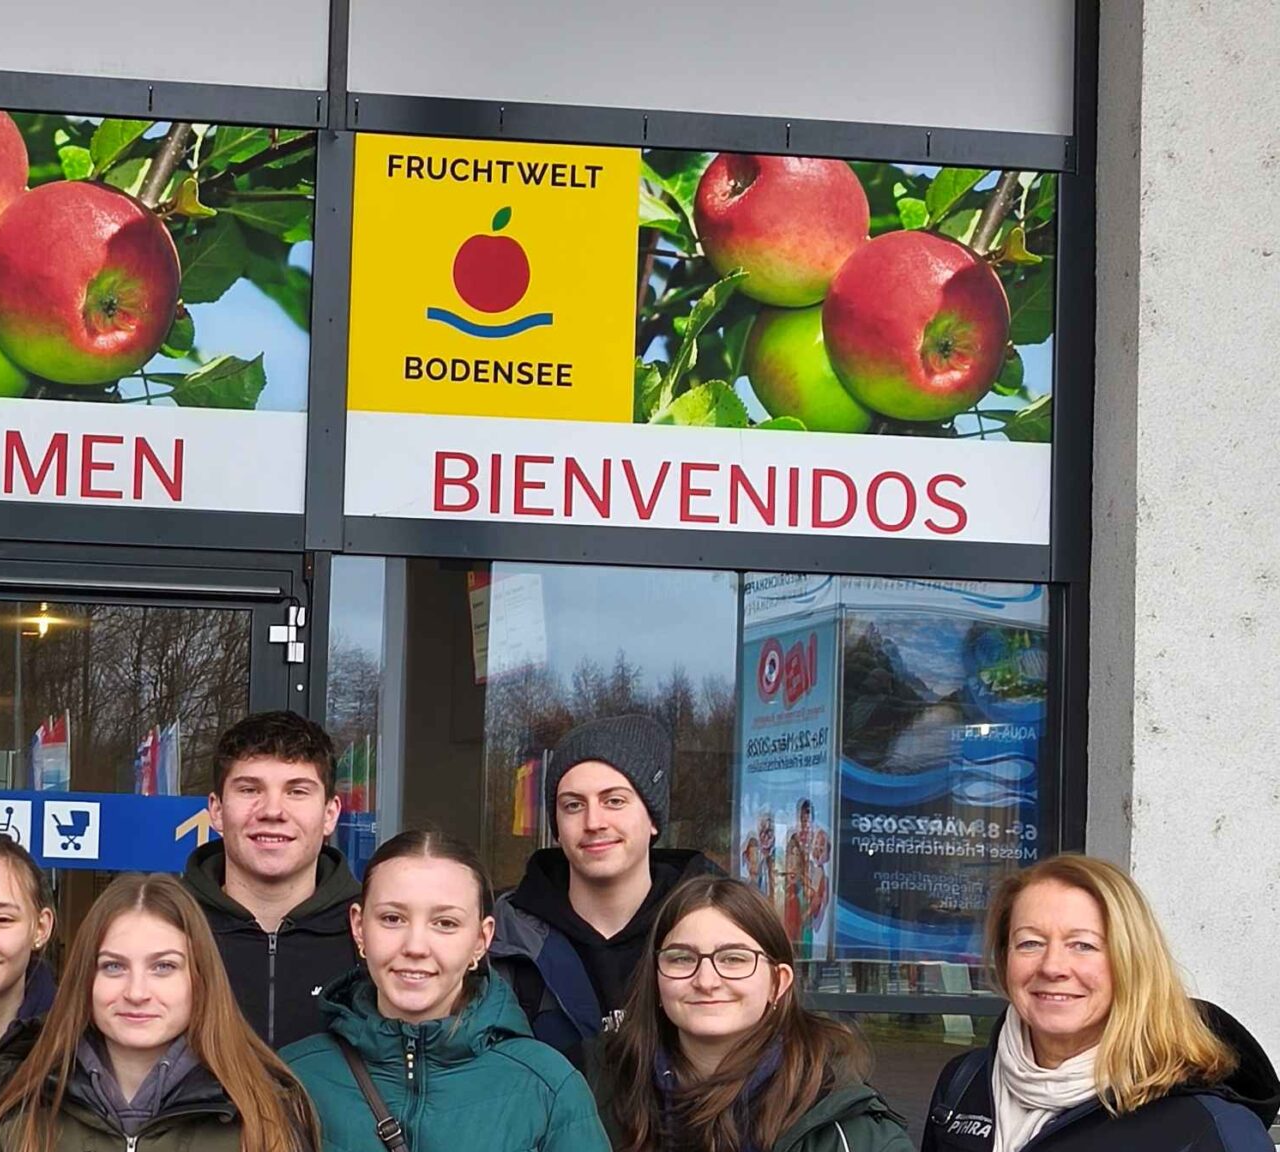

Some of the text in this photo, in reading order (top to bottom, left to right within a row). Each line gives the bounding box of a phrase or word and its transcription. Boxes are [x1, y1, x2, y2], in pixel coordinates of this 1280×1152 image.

[387, 154, 603, 188] FRUCHTWELT
[404, 356, 573, 387] BODENSEE
[433, 450, 968, 535] BIENVENIDOS
